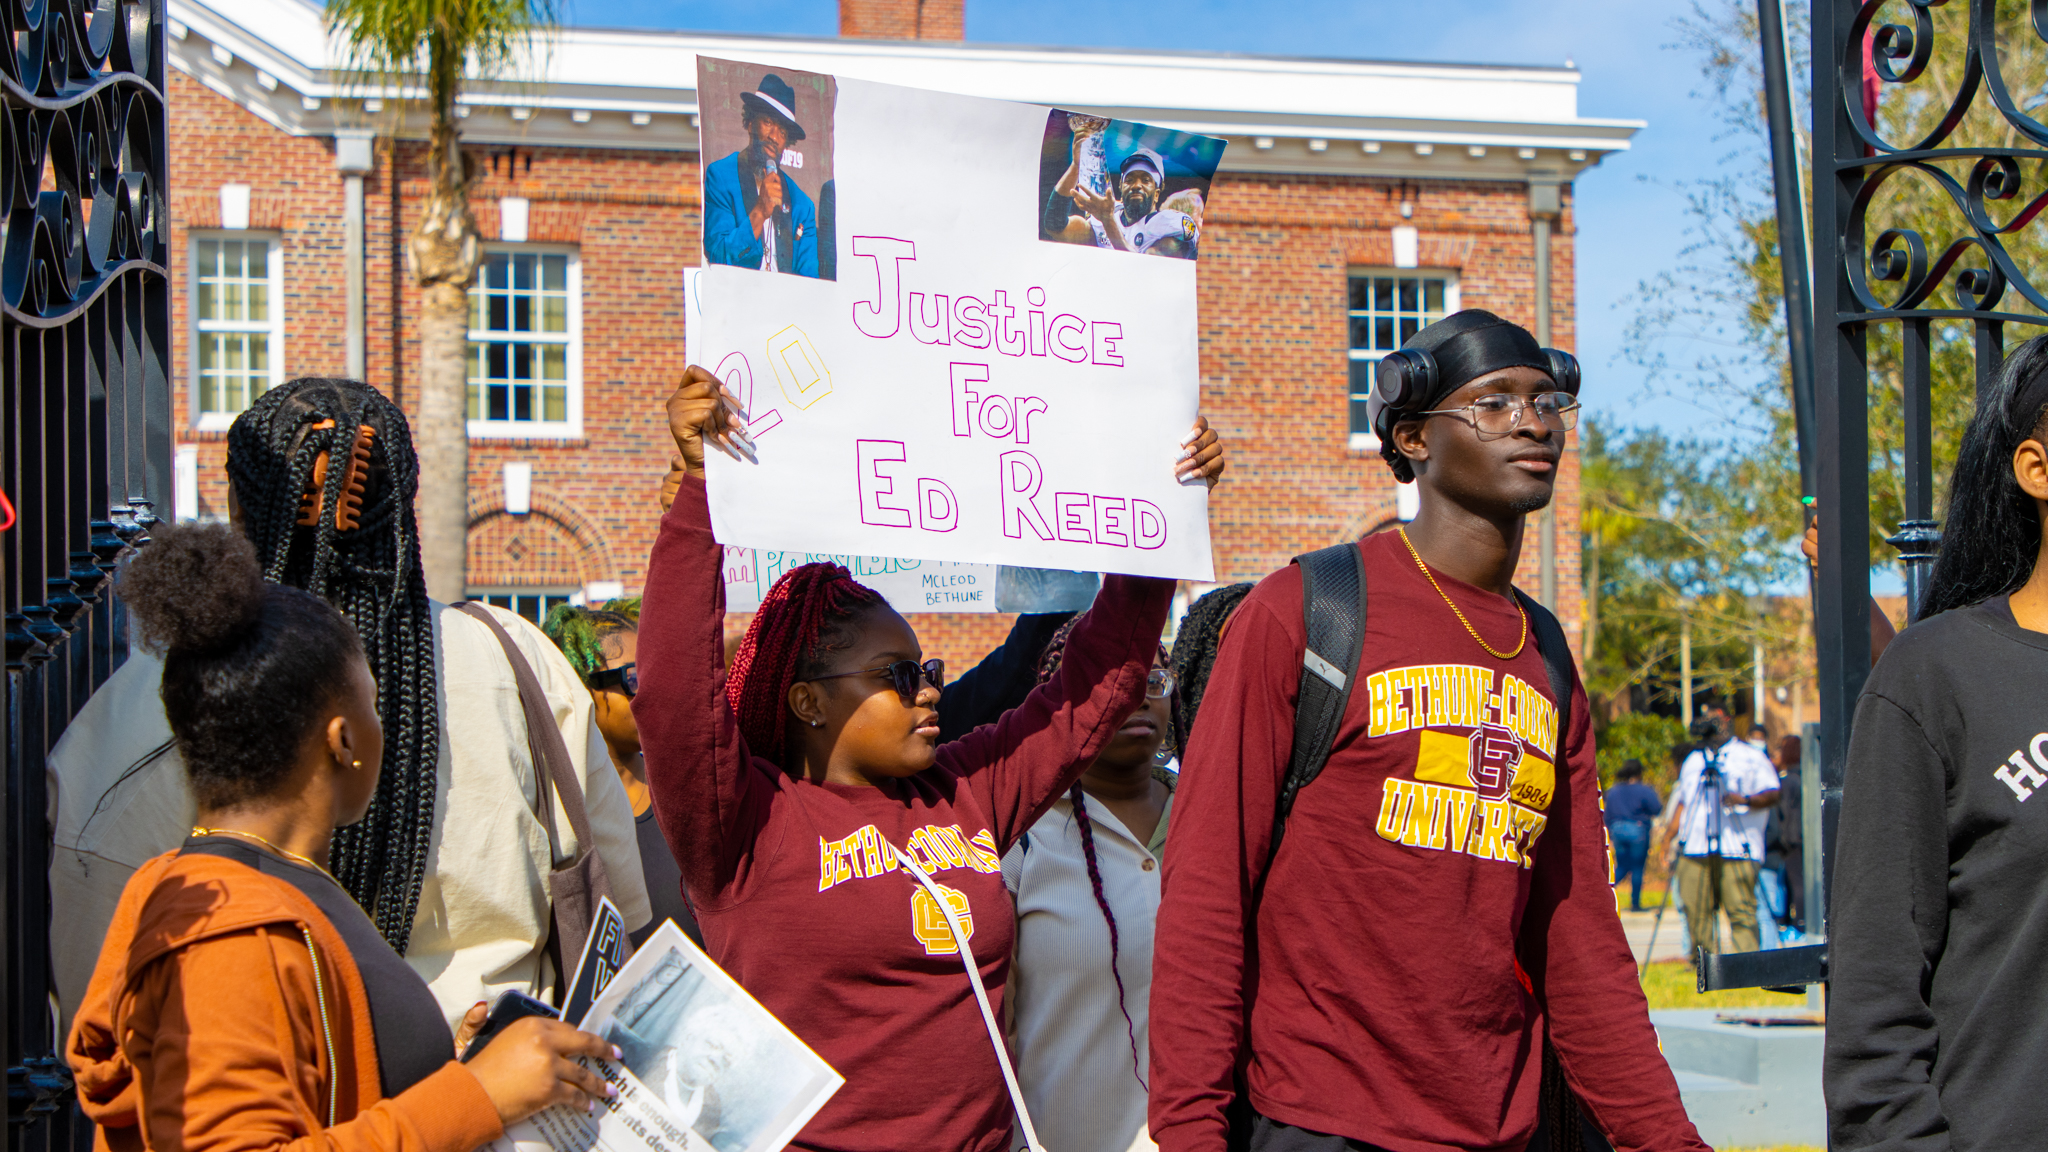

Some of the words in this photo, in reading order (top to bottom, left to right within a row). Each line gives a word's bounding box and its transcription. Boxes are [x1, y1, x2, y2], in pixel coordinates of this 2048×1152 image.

[949, 362, 1047, 443] For
[856, 439, 958, 532] ED
[1000, 450, 1167, 549] REED
[922, 573, 977, 588] MCLEOD
[925, 590, 983, 606] BETHUNE
[1516, 783, 1549, 808] 1904
